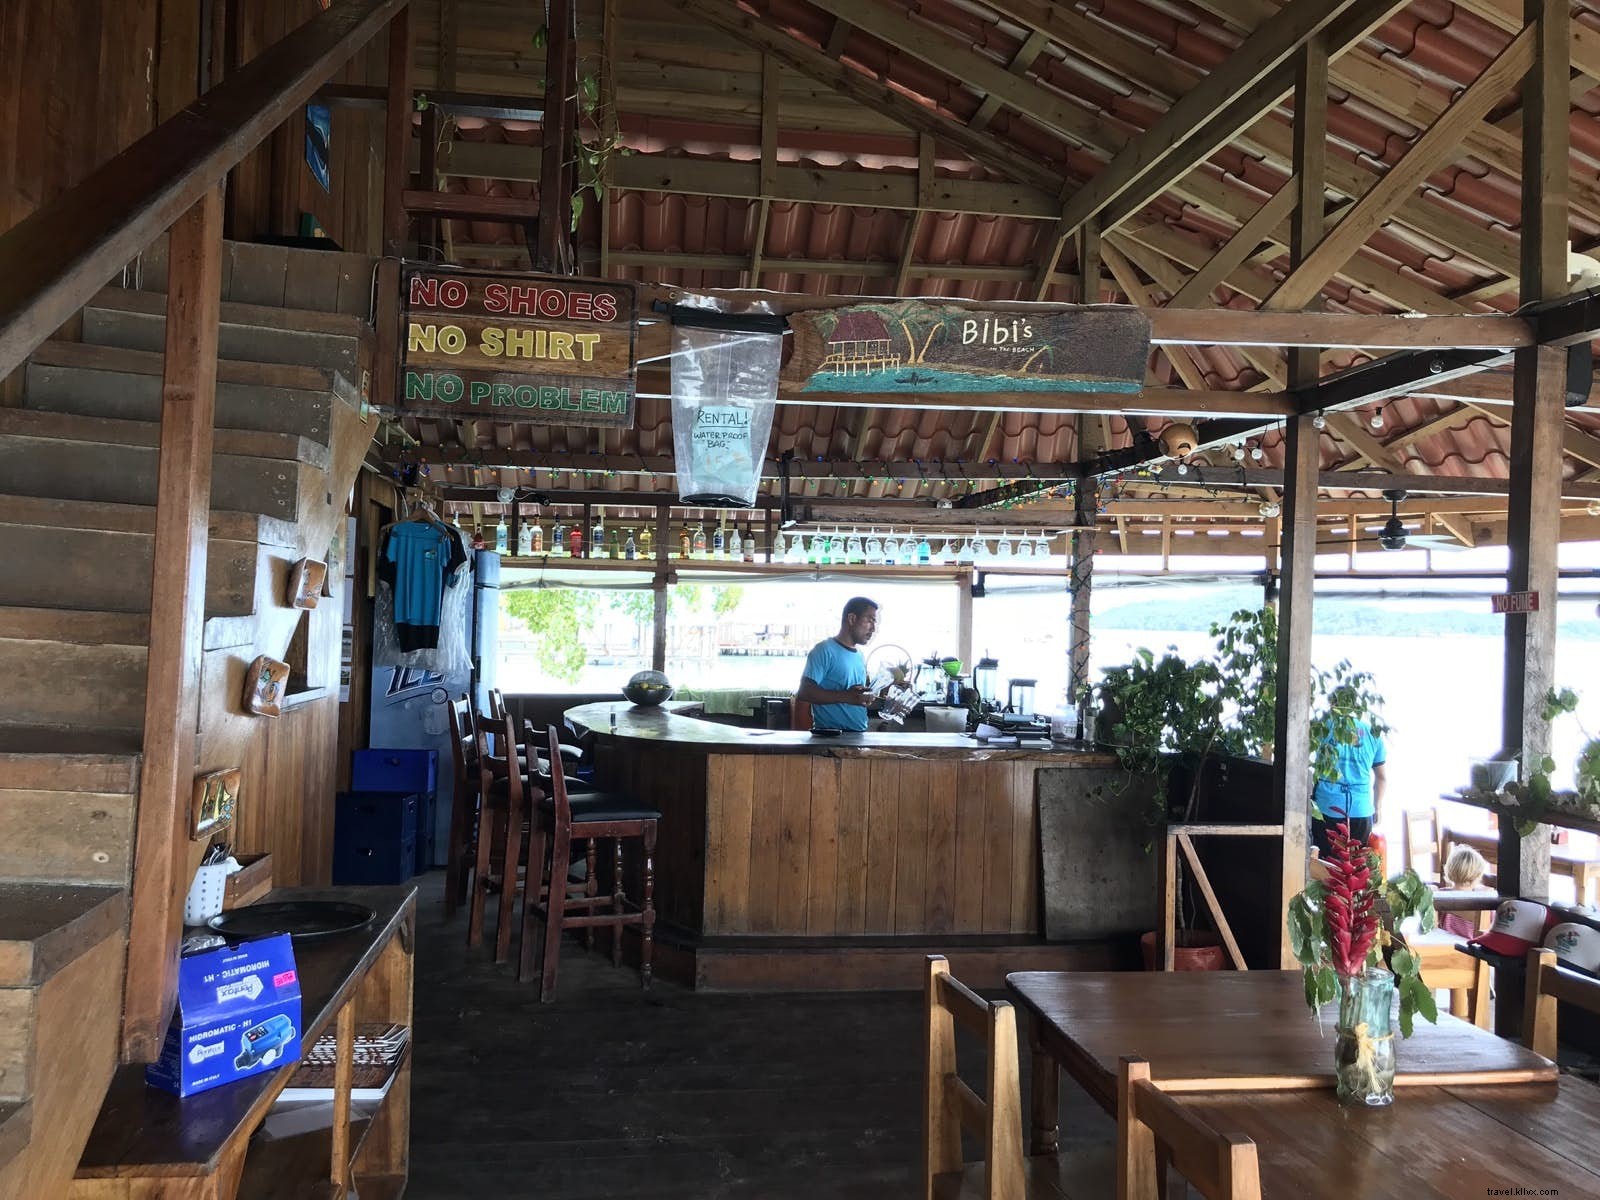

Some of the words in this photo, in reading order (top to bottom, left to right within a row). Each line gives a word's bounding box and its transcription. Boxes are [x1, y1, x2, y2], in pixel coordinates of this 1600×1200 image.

[410, 278, 468, 308] NO
[483, 284, 617, 322] SHOES
[408, 323, 466, 354] NO
[480, 327, 600, 361] SHIRT
[962, 318, 1033, 345] Bibi's
[406, 372, 464, 402] NO
[470, 381, 628, 414] PROBLEM
[697, 408, 748, 425] RENTAL!
[1496, 595, 1509, 612] NO
[1510, 593, 1534, 611] FUME
